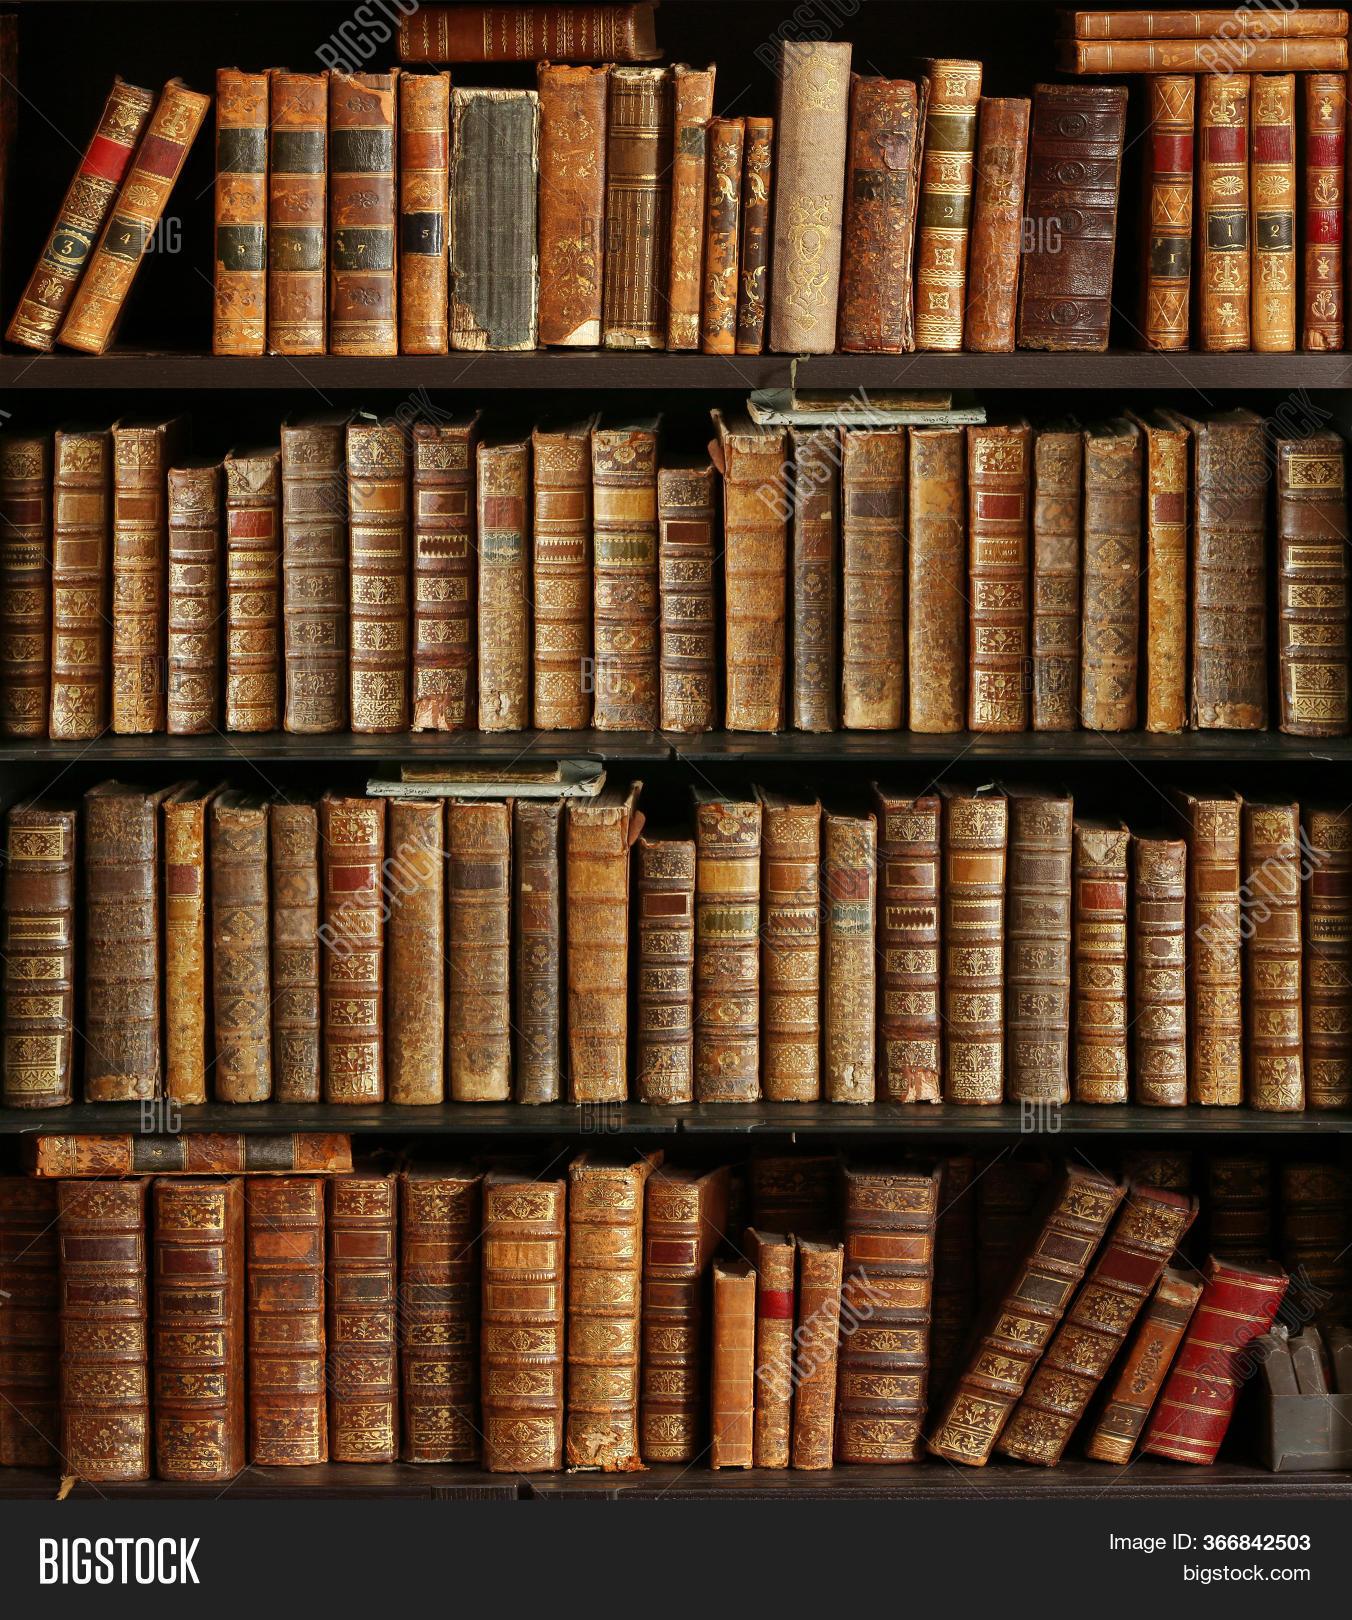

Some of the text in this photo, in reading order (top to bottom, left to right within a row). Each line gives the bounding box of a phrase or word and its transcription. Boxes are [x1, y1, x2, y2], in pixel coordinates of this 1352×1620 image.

[943, 206, 954, 218] 2
[421, 229, 430, 239] 5
[1228, 224, 1233, 237] 1
[1270, 224, 1280, 237] 2
[120, 232, 131, 245] 4
[61, 239, 75, 255] 3
[237, 245, 246, 254] 5
[293, 242, 302, 252] 6
[357, 244, 367, 254] 7
